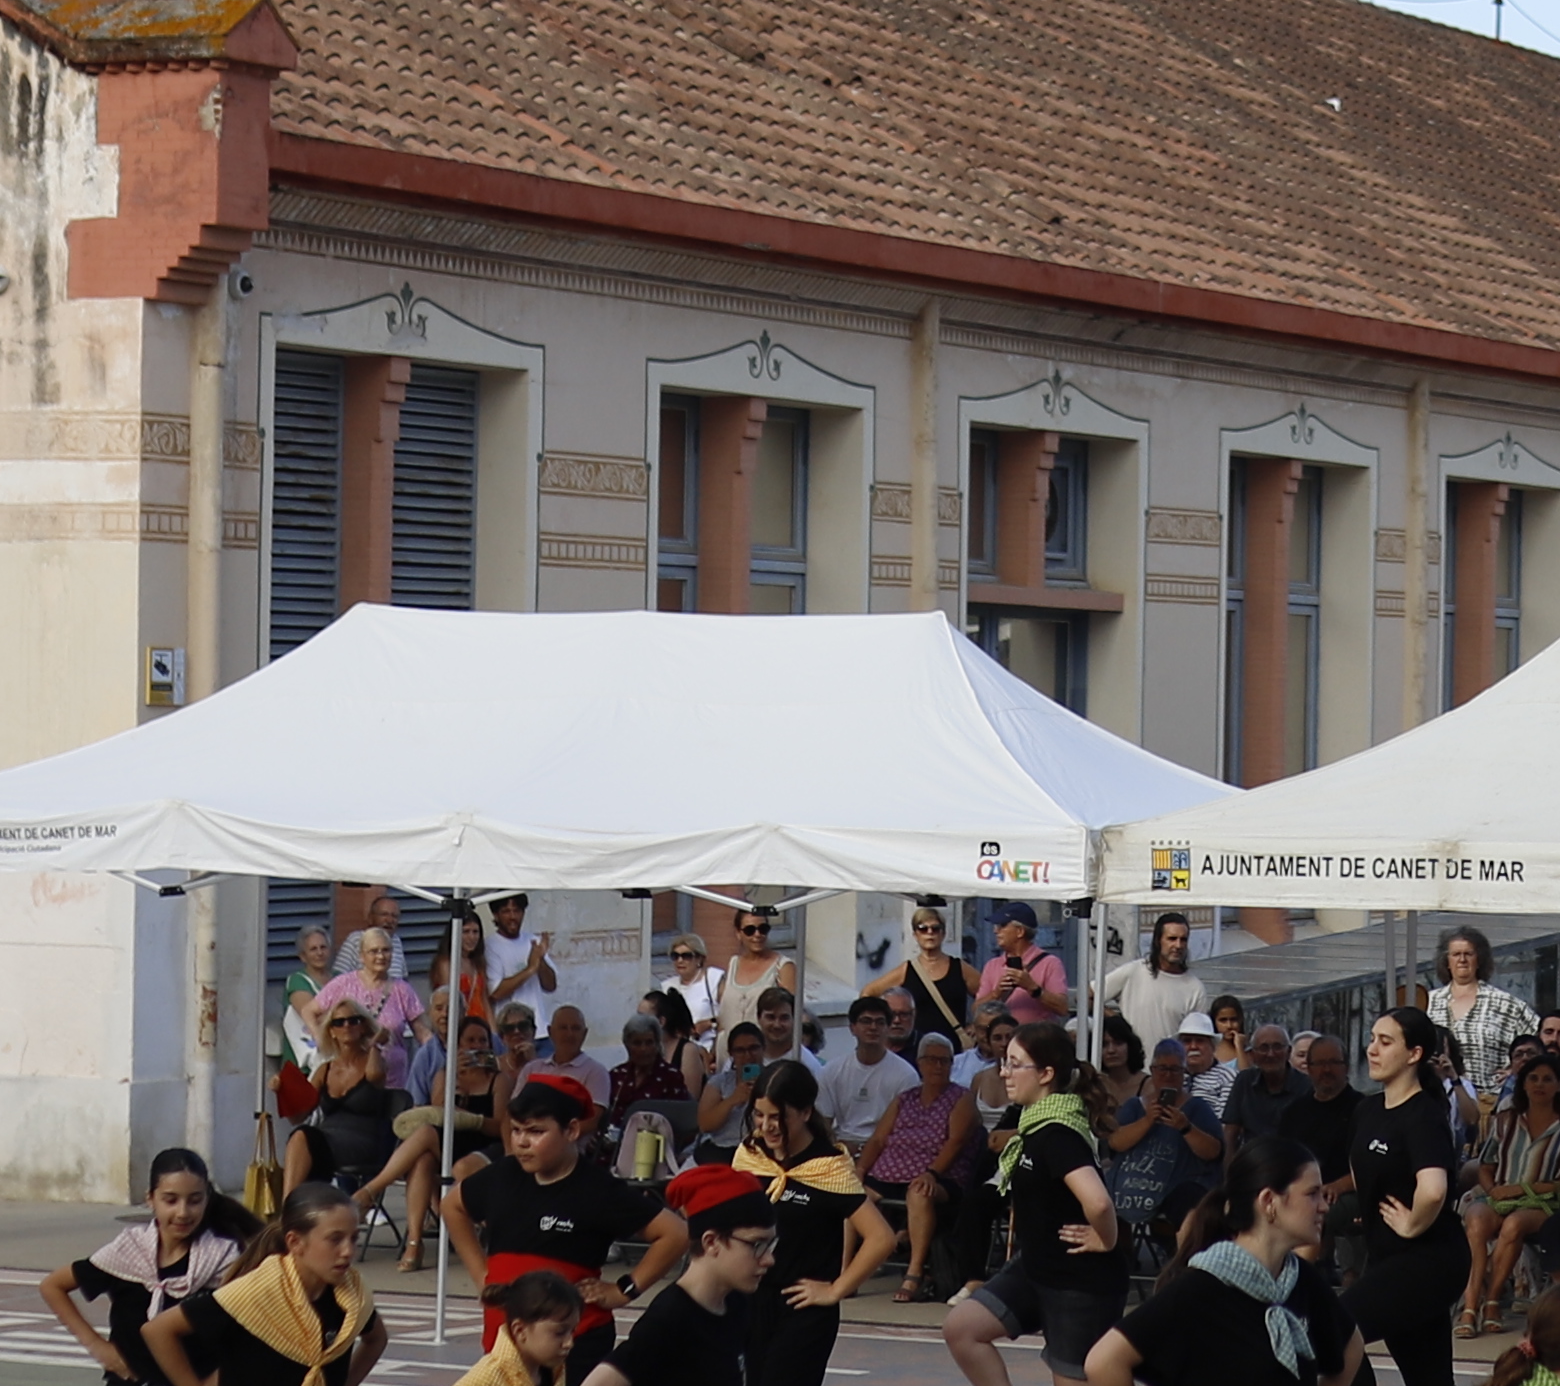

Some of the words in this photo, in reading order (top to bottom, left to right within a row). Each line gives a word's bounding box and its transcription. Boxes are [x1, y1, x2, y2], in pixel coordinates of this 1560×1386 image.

[25, 827, 38, 840] DE
[41, 826, 75, 840] CANET
[78, 825, 92, 839] DE
[95, 824, 118, 838] MAR
[976, 859, 1050, 884] CANET!
[1201, 854, 1333, 877] AJUNTAMENT
[1340, 857, 1365, 879] DE
[1372, 857, 1438, 880] CANET
[1445, 858, 1472, 881] DE
[1479, 859, 1525, 882] MAR
